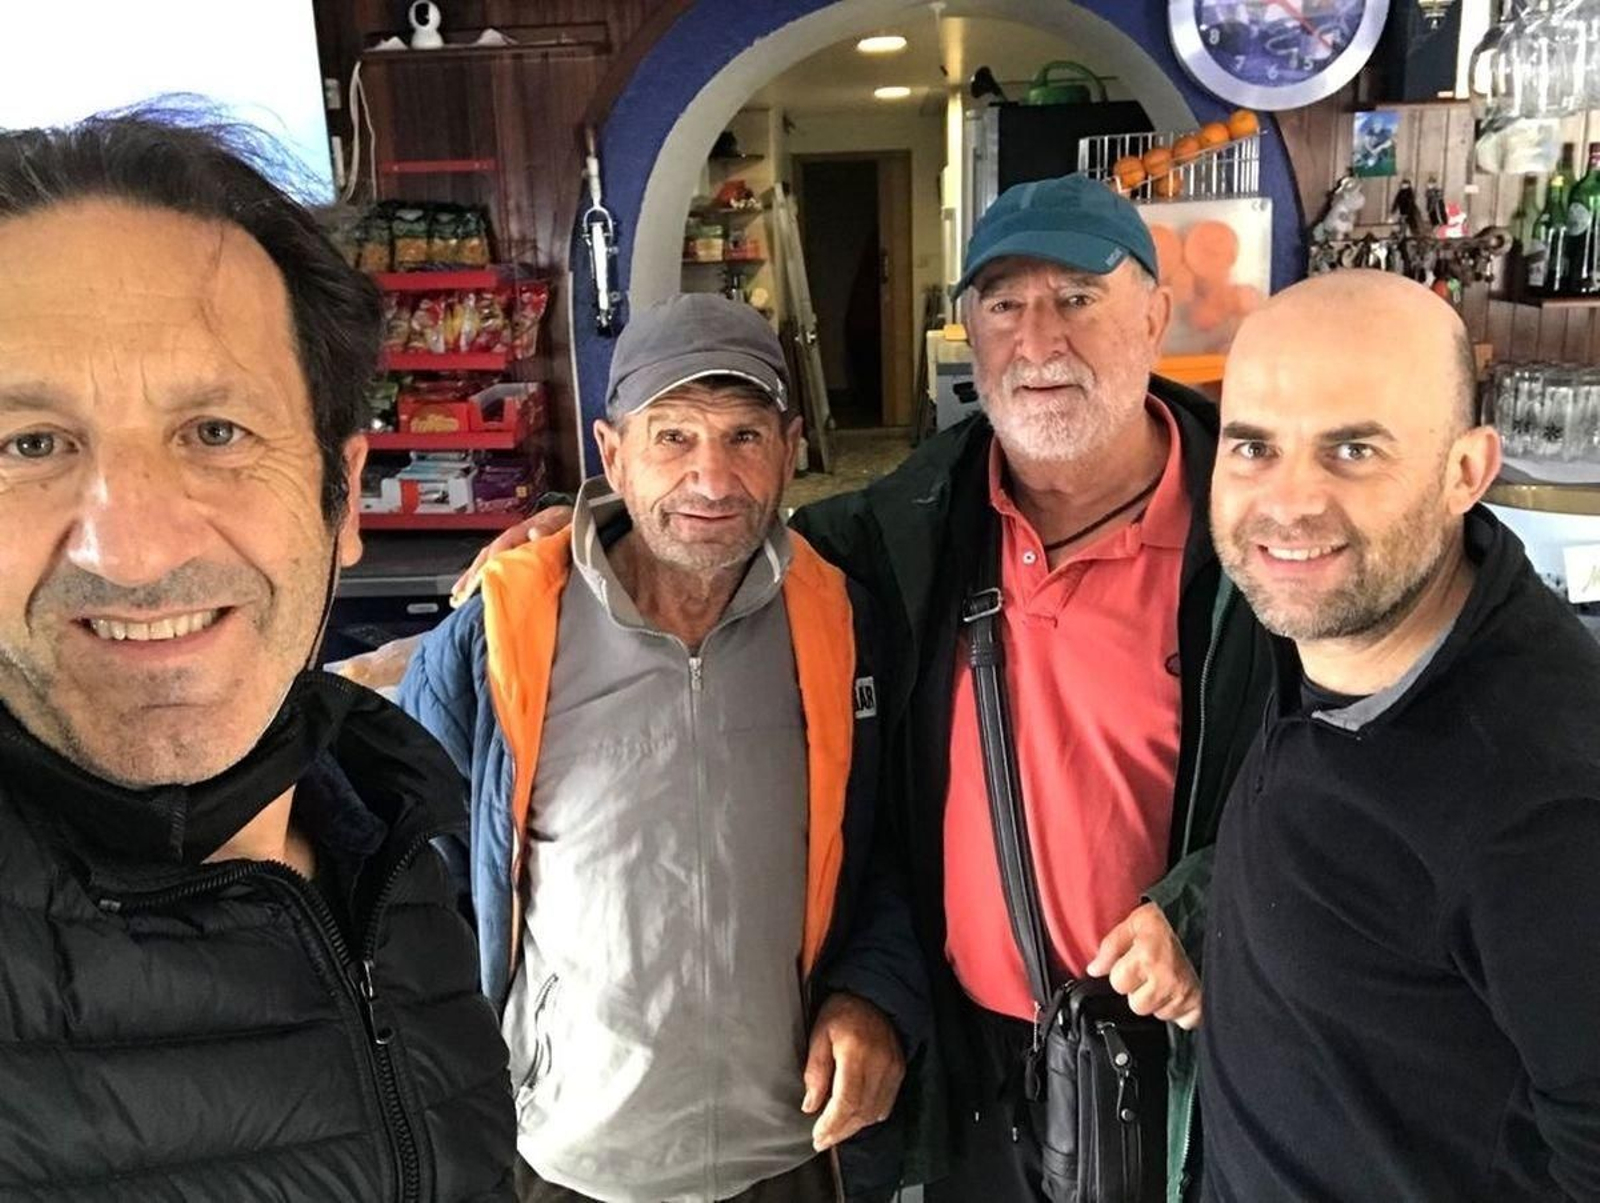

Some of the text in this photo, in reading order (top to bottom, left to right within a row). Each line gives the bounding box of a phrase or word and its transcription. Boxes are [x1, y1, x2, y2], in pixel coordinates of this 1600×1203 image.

[1209, 28, 1220, 45] 8
[1235, 55, 1246, 71] 7
[1303, 57, 1314, 70] 5
[1267, 64, 1279, 80] 6
[855, 686, 874, 711] AR
